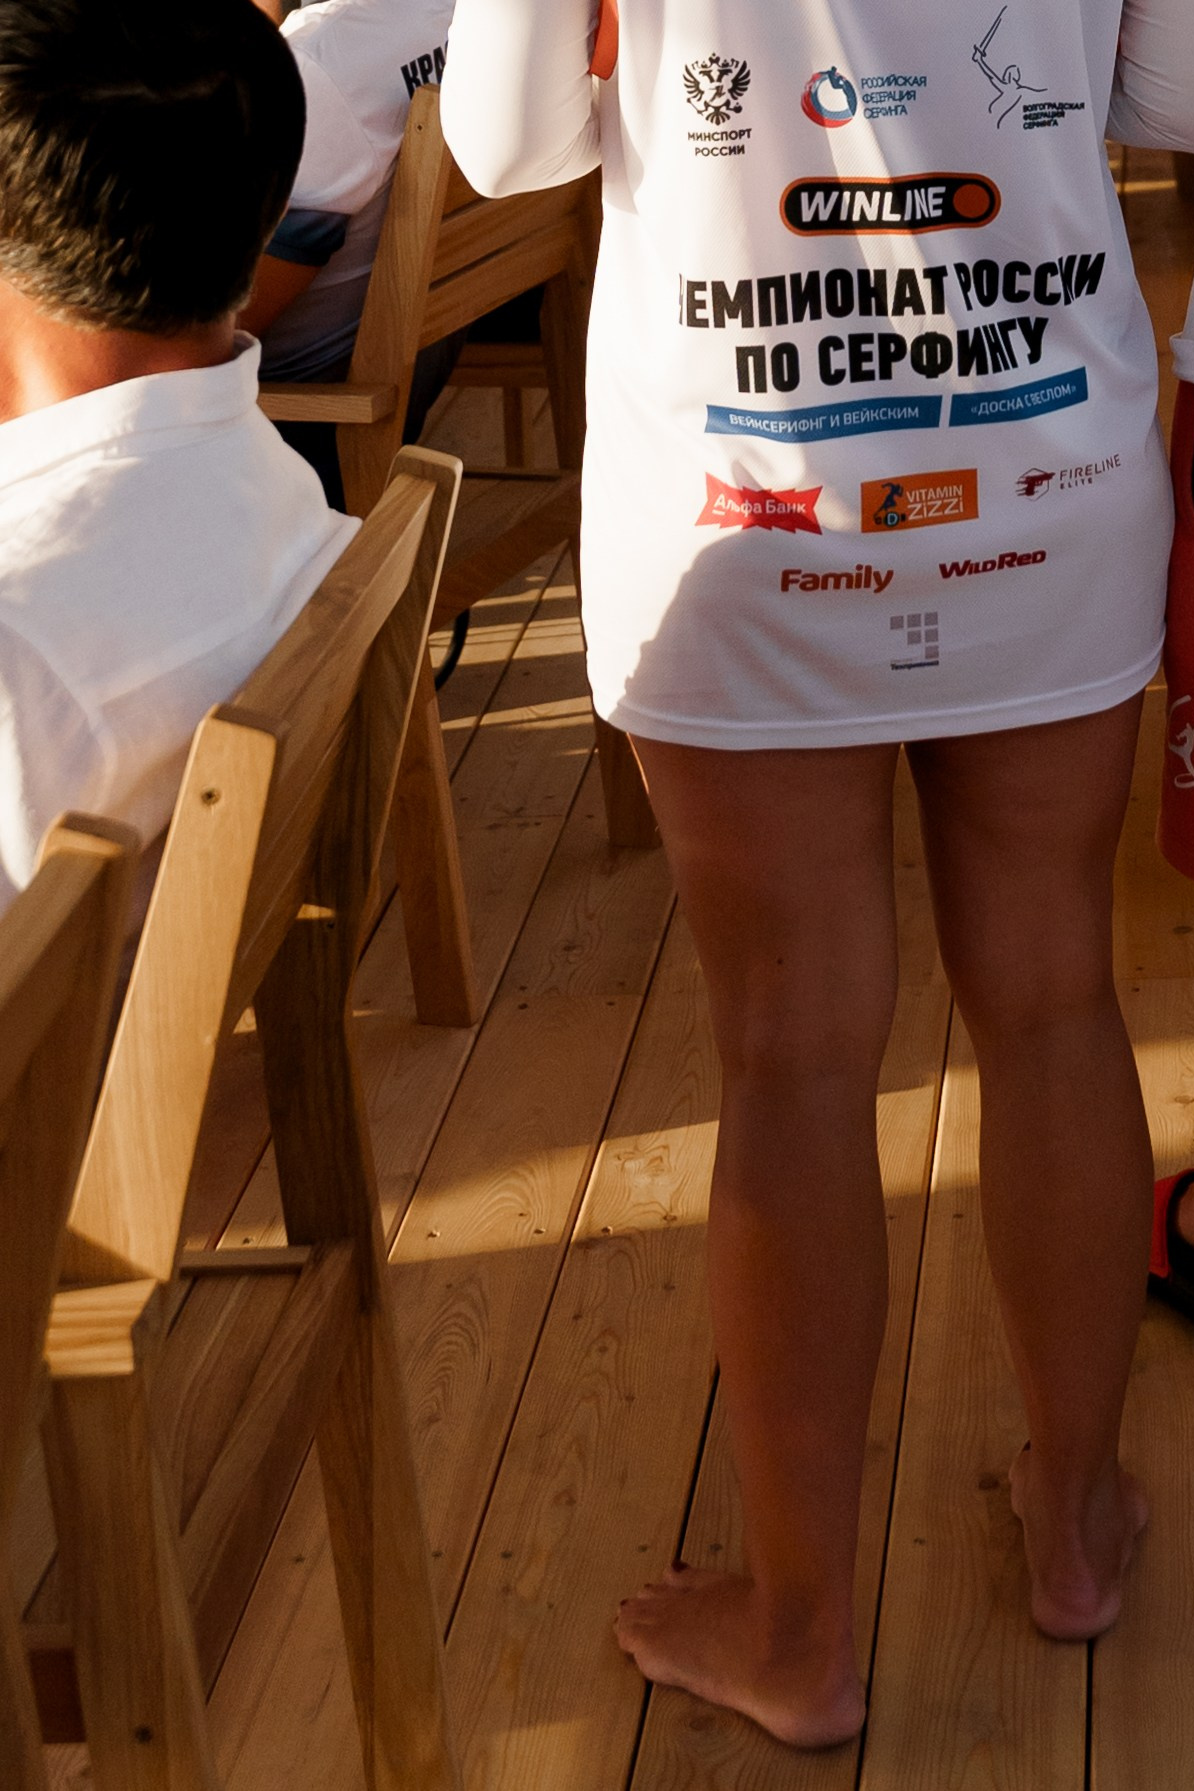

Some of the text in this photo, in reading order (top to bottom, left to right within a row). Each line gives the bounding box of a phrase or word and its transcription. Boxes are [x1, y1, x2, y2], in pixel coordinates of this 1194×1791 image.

[400, 40, 448, 100] КРА
[687, 128, 752, 141] МИНСПОРТ
[695, 144, 746, 157] РОССИИ
[801, 186, 946, 222] WINLINE
[679, 265, 948, 328] ЕМПИОНАТ
[736, 316, 1049, 393] ПО СЕРФИНГУ
[830, 414, 840, 427] И
[843, 406, 919, 425] ВЕЙКСКИМ
[1060, 454, 1121, 480] FIRELINE
[906, 484, 963, 503] VITAMIN
[1060, 477, 1093, 489] ELITE
[713, 493, 806, 517] Альфа Банк
[781, 564, 894, 594] Family
